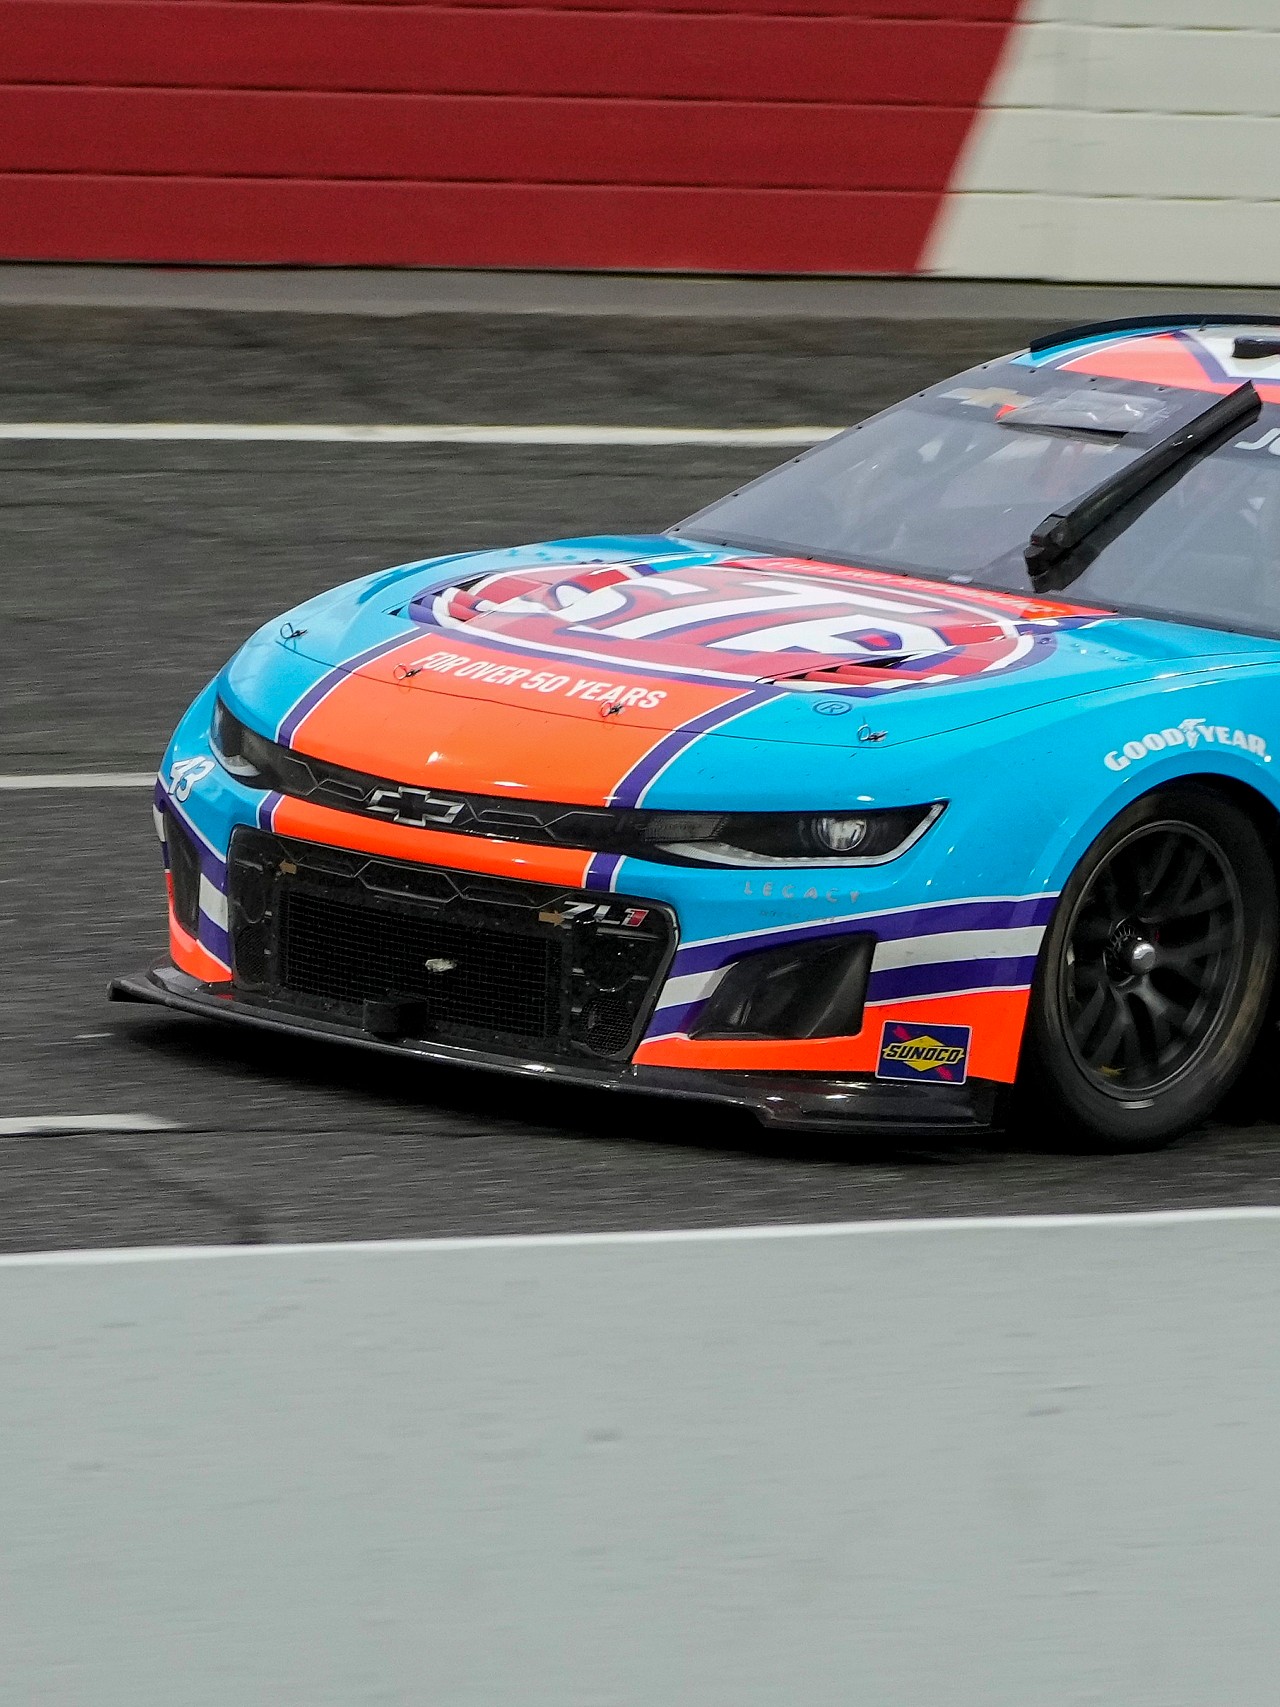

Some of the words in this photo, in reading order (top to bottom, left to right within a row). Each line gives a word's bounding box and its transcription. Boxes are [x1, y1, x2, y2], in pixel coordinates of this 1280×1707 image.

[412, 650, 464, 674] FOR
[454, 657, 528, 686] OVER
[520, 671, 571, 694] 50
[565, 679, 667, 710] YEARS
[1104, 719, 1267, 772] GOODYEAR
[169, 756, 216, 802] 43
[886, 1044, 962, 1063] SUNOCO
